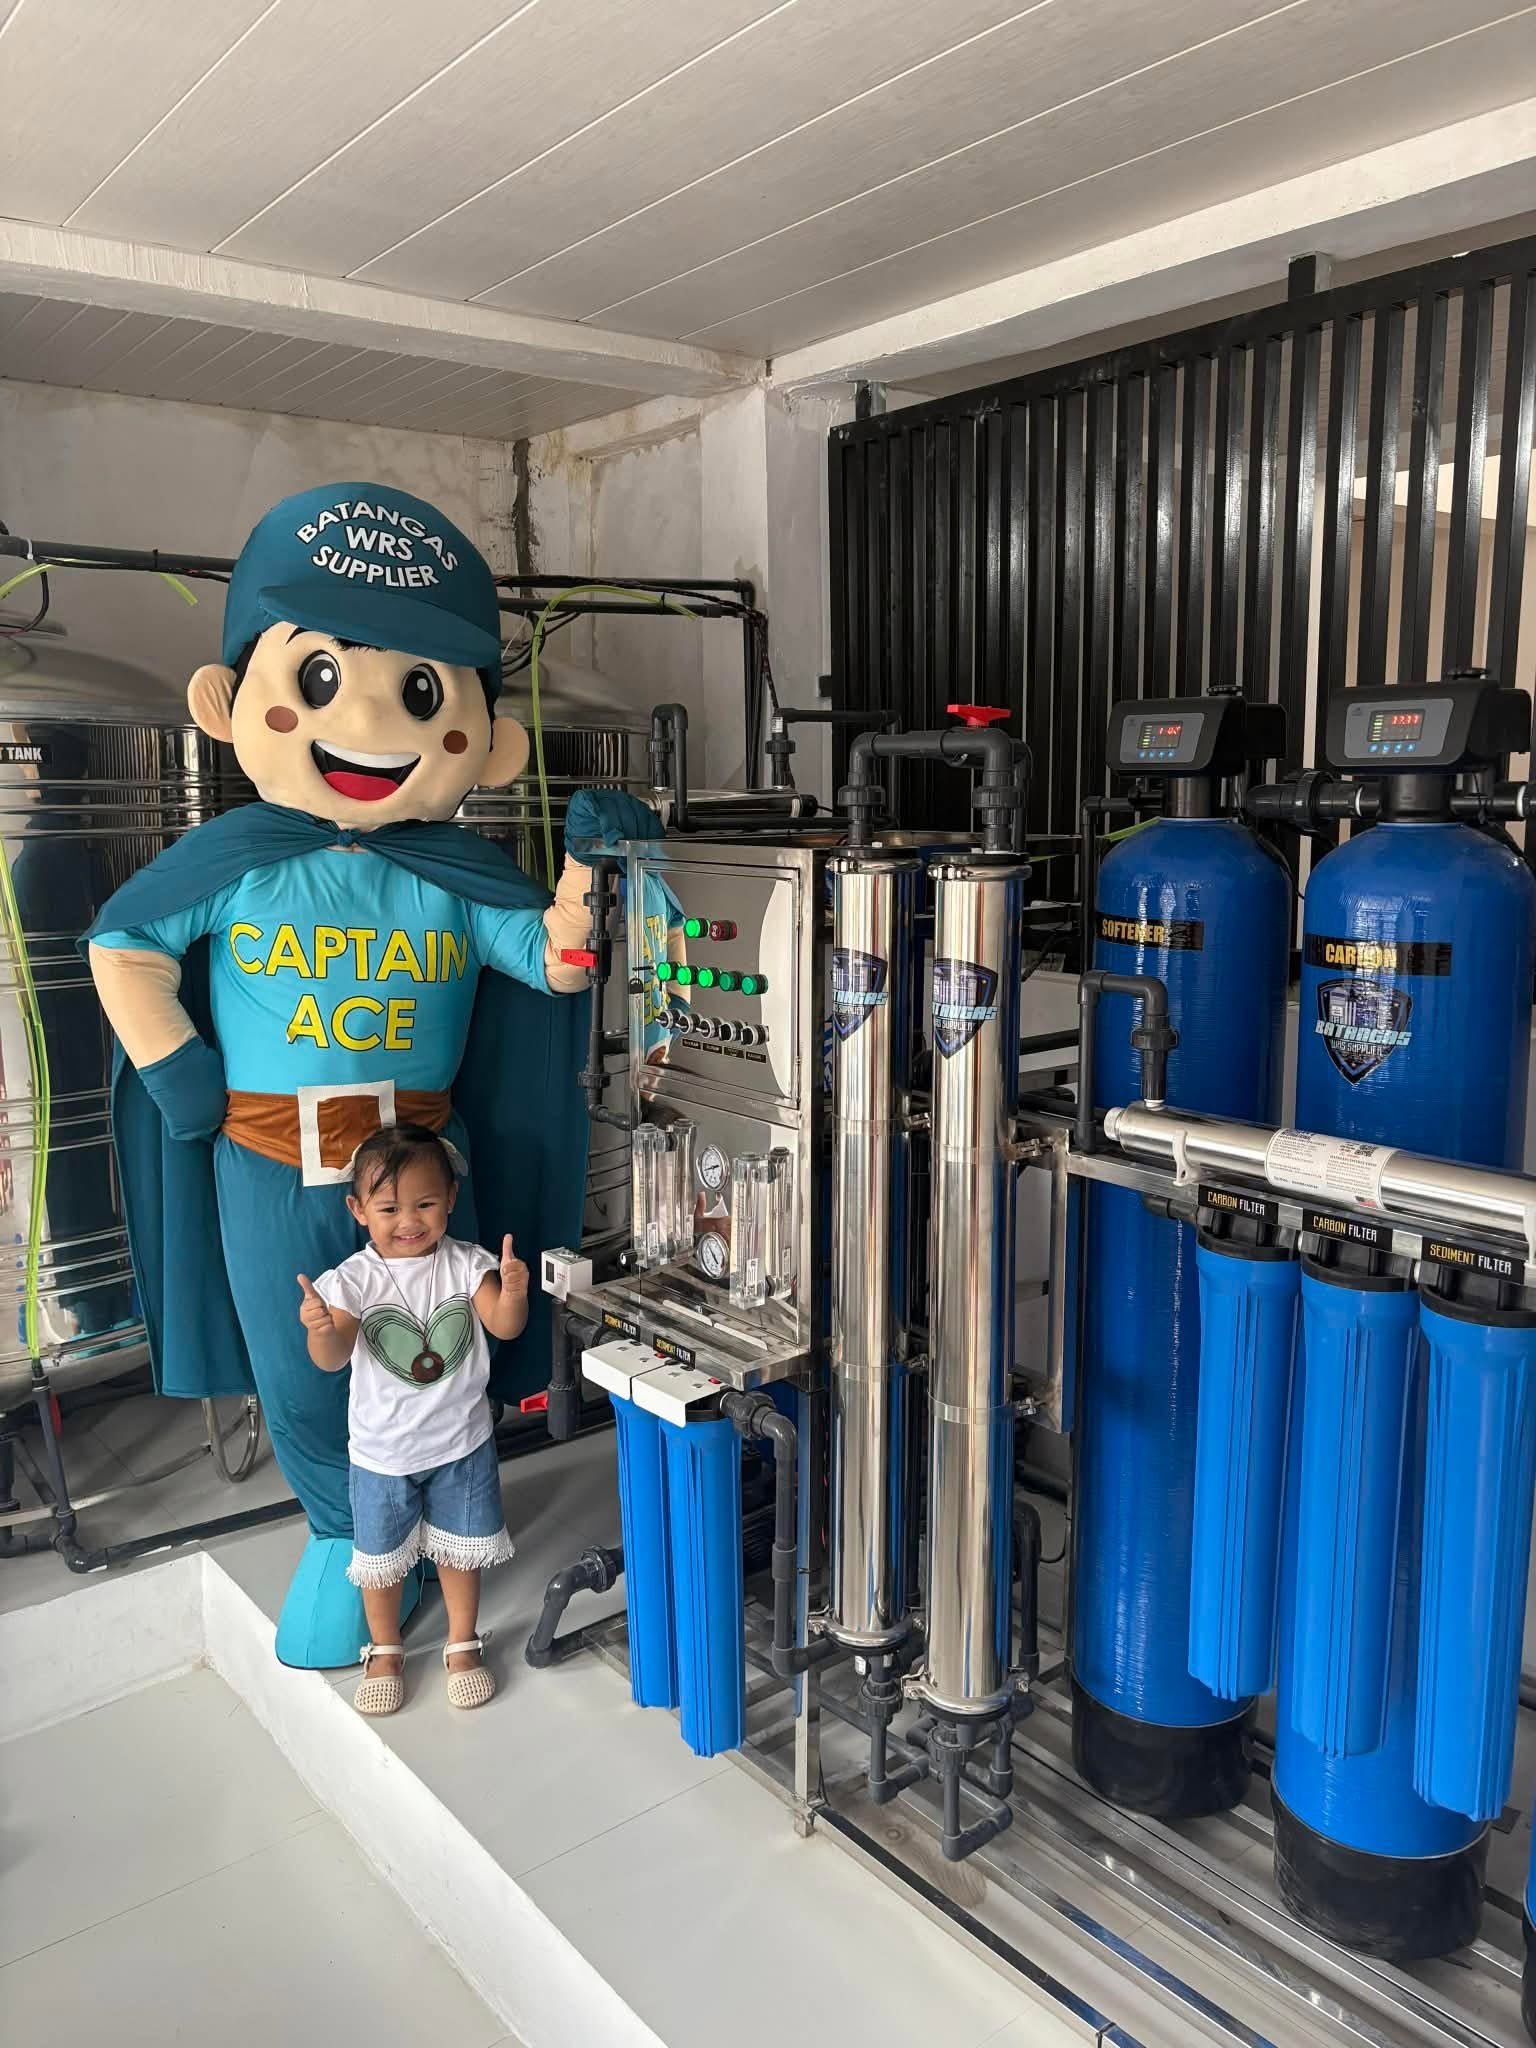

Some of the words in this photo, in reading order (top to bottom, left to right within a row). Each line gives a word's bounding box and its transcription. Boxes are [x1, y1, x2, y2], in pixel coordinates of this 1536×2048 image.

[296, 501, 458, 571] BATANGAS
[345, 525, 414, 561] WRS
[312, 545, 440, 587] SUPPLIER
[6, 747, 43, 760] TANK
[229, 922, 468, 982] CAPTAIN
[286, 994, 417, 1051] ACE
[1314, 1020, 1412, 1046] BATANGAS
[1207, 1191, 1237, 1209] CARBON
[1239, 1198, 1265, 1216] FILTER
[1313, 1215, 1346, 1235] CARBON
[1348, 1223, 1377, 1242] FILTER
[1430, 1243, 1475, 1267] SEDIMENT
[1478, 1255, 1512, 1276] FILTER
